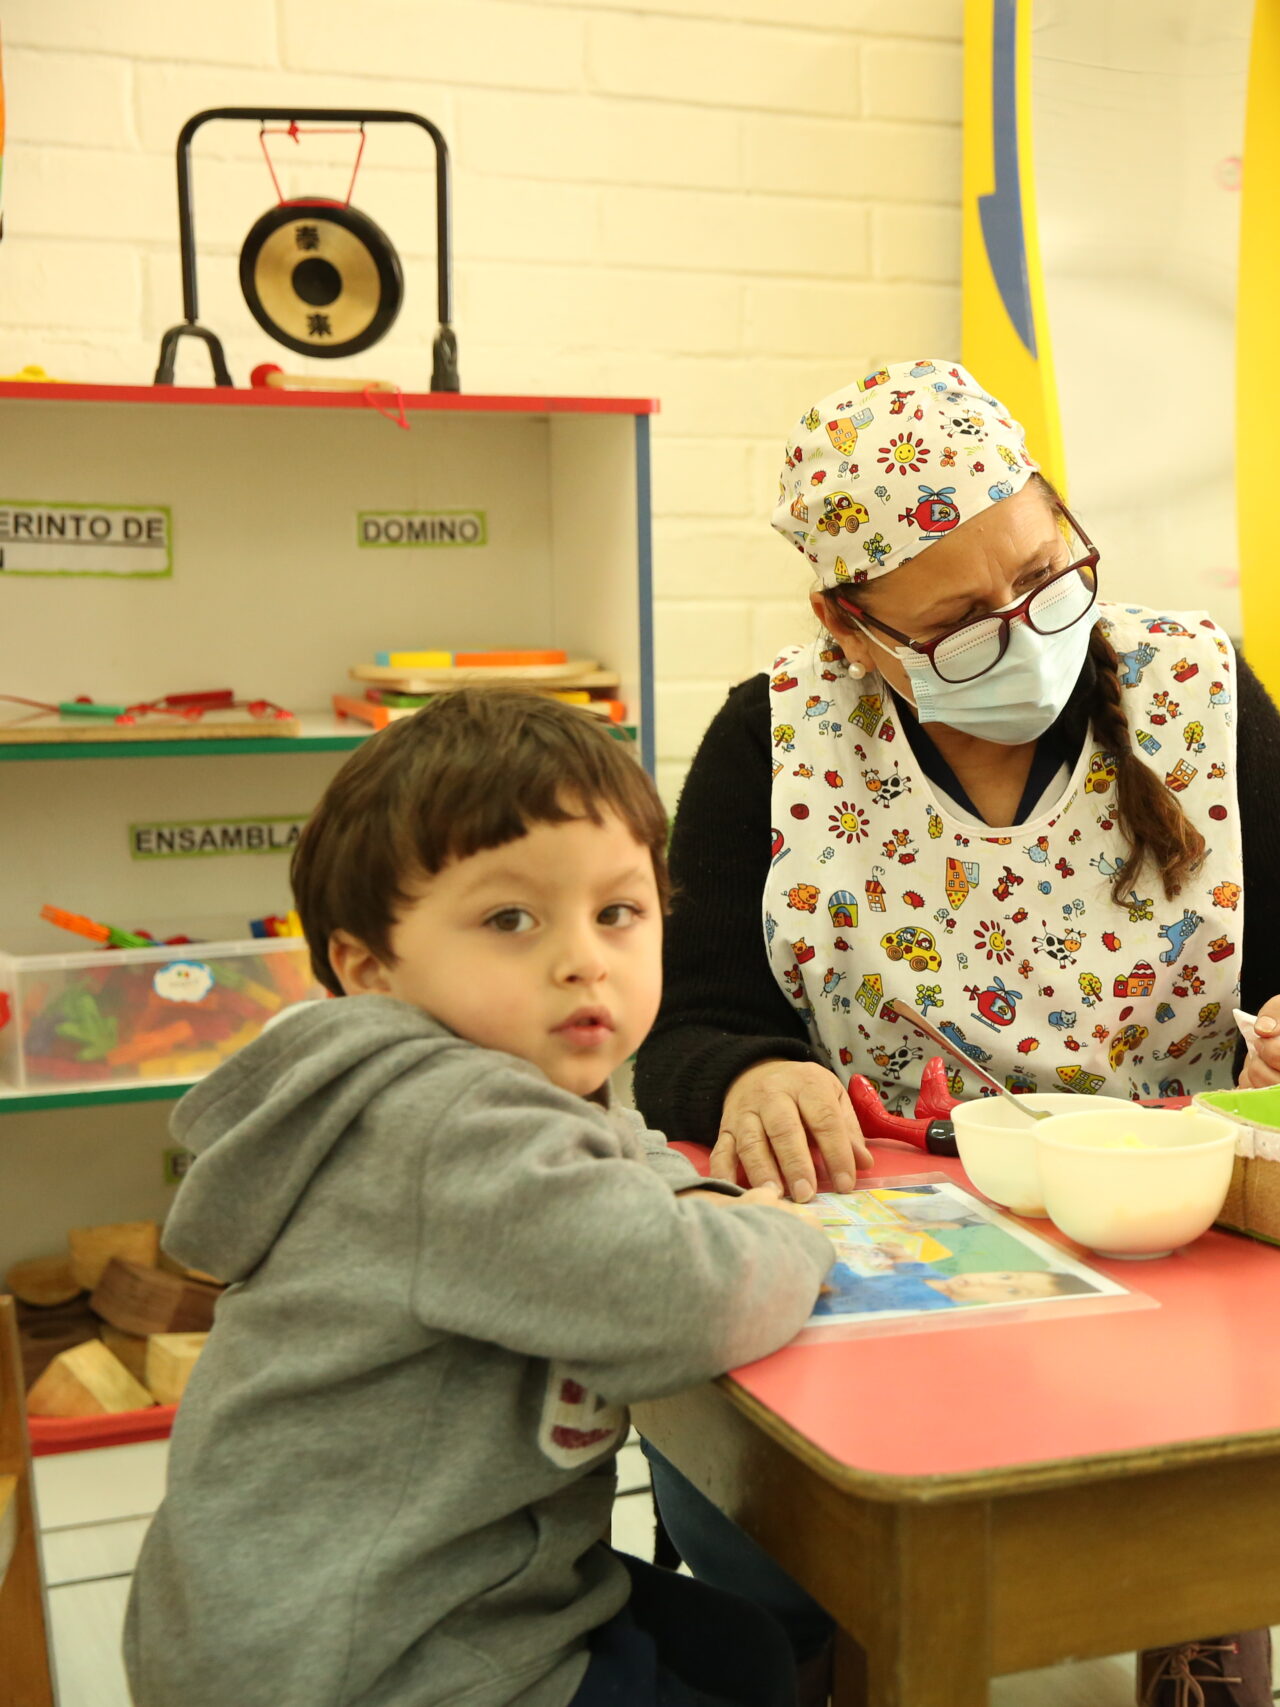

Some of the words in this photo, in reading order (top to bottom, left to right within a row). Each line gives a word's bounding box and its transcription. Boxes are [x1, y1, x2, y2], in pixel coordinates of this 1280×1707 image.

[123, 516, 164, 541] DE
[363, 518, 479, 543] DOMINO
[135, 824, 300, 852] ENSAMBLA
